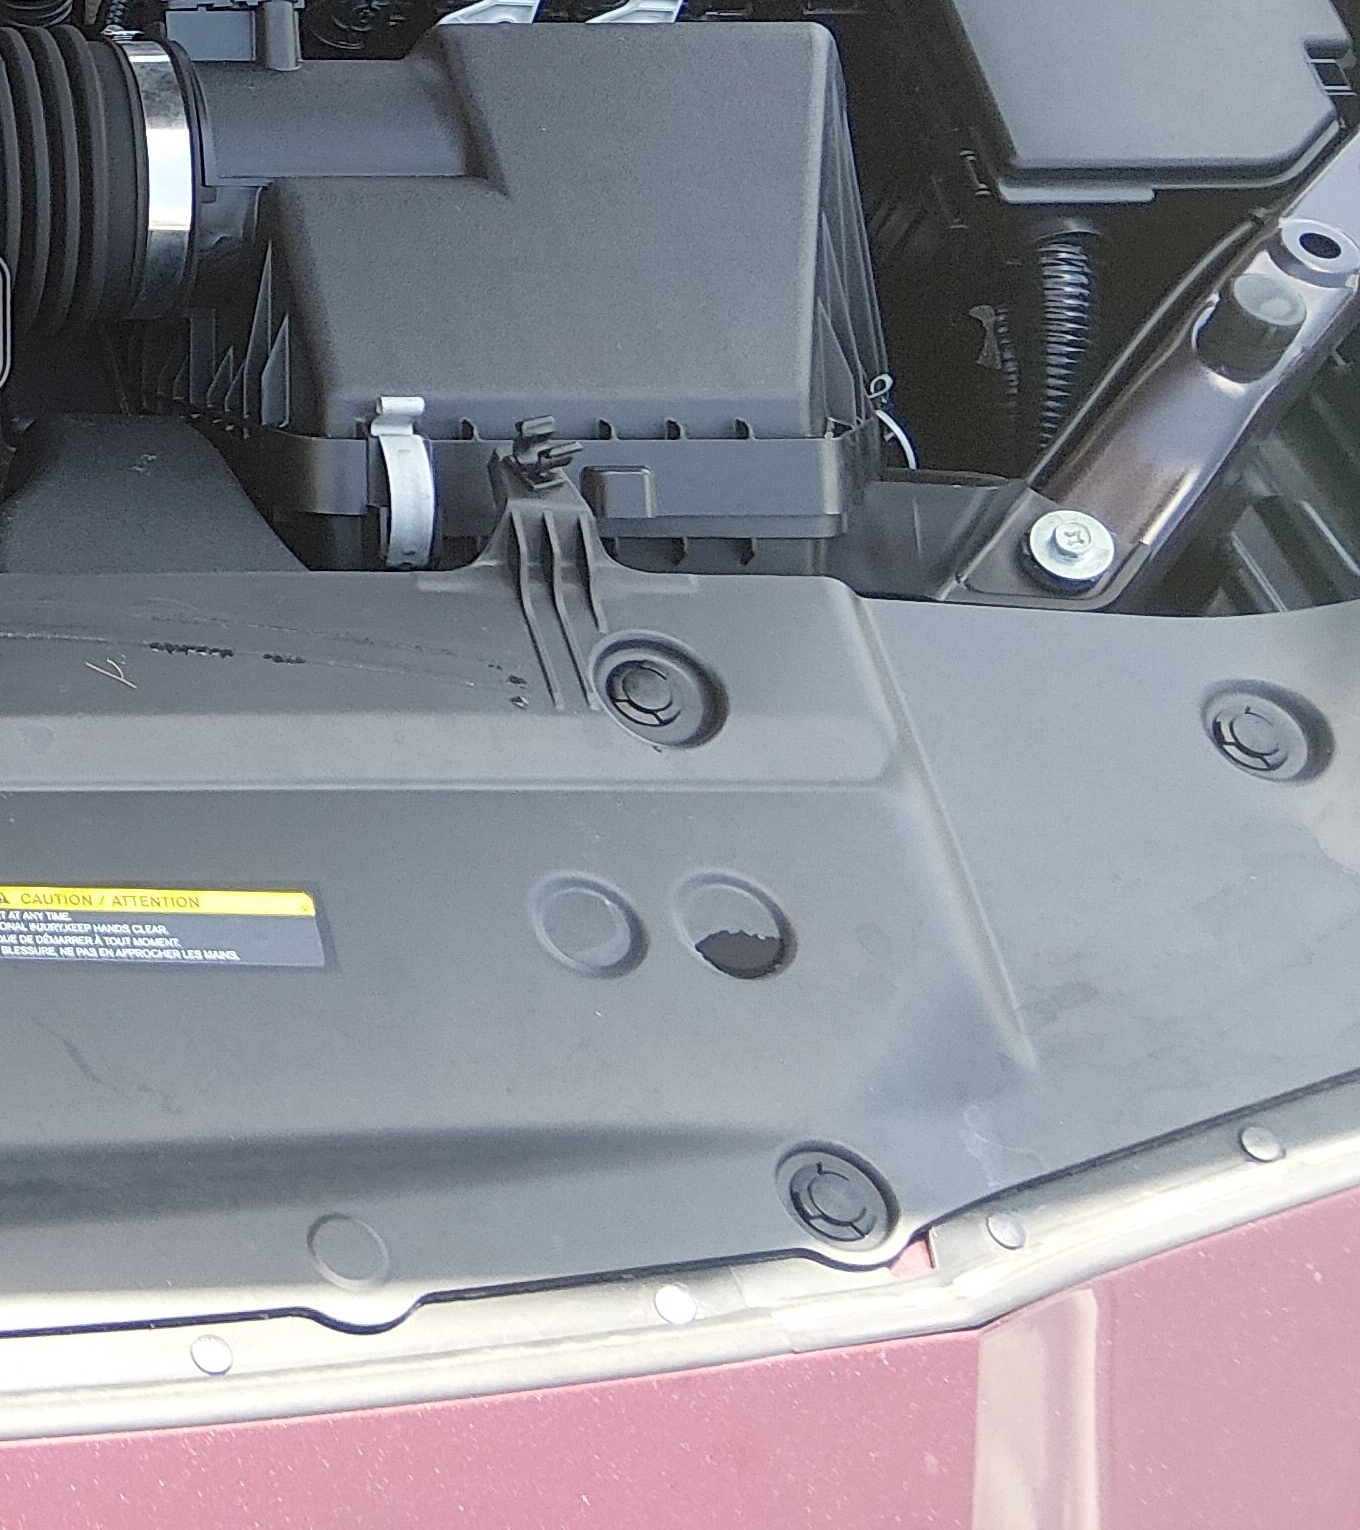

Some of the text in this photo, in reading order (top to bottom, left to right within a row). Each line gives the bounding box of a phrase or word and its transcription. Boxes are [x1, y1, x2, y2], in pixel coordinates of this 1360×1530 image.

[21, 893, 93, 906] CAUTION
[112, 895, 200, 908] ATTENTION
[8, 910, 21, 920] AT
[23, 911, 45, 920] ANY
[93, 923, 130, 934] HANDS
[19, 934, 33, 944] DE
[36, 933, 94, 945] DÉMARRER
[104, 936, 131, 946] TOUT
[60, 947, 75, 956] NE
[76, 947, 97, 957] PAS
[99, 947, 114, 958] EN
[115, 948, 180, 960] APPROCHER
[182, 949, 201, 960] LES
